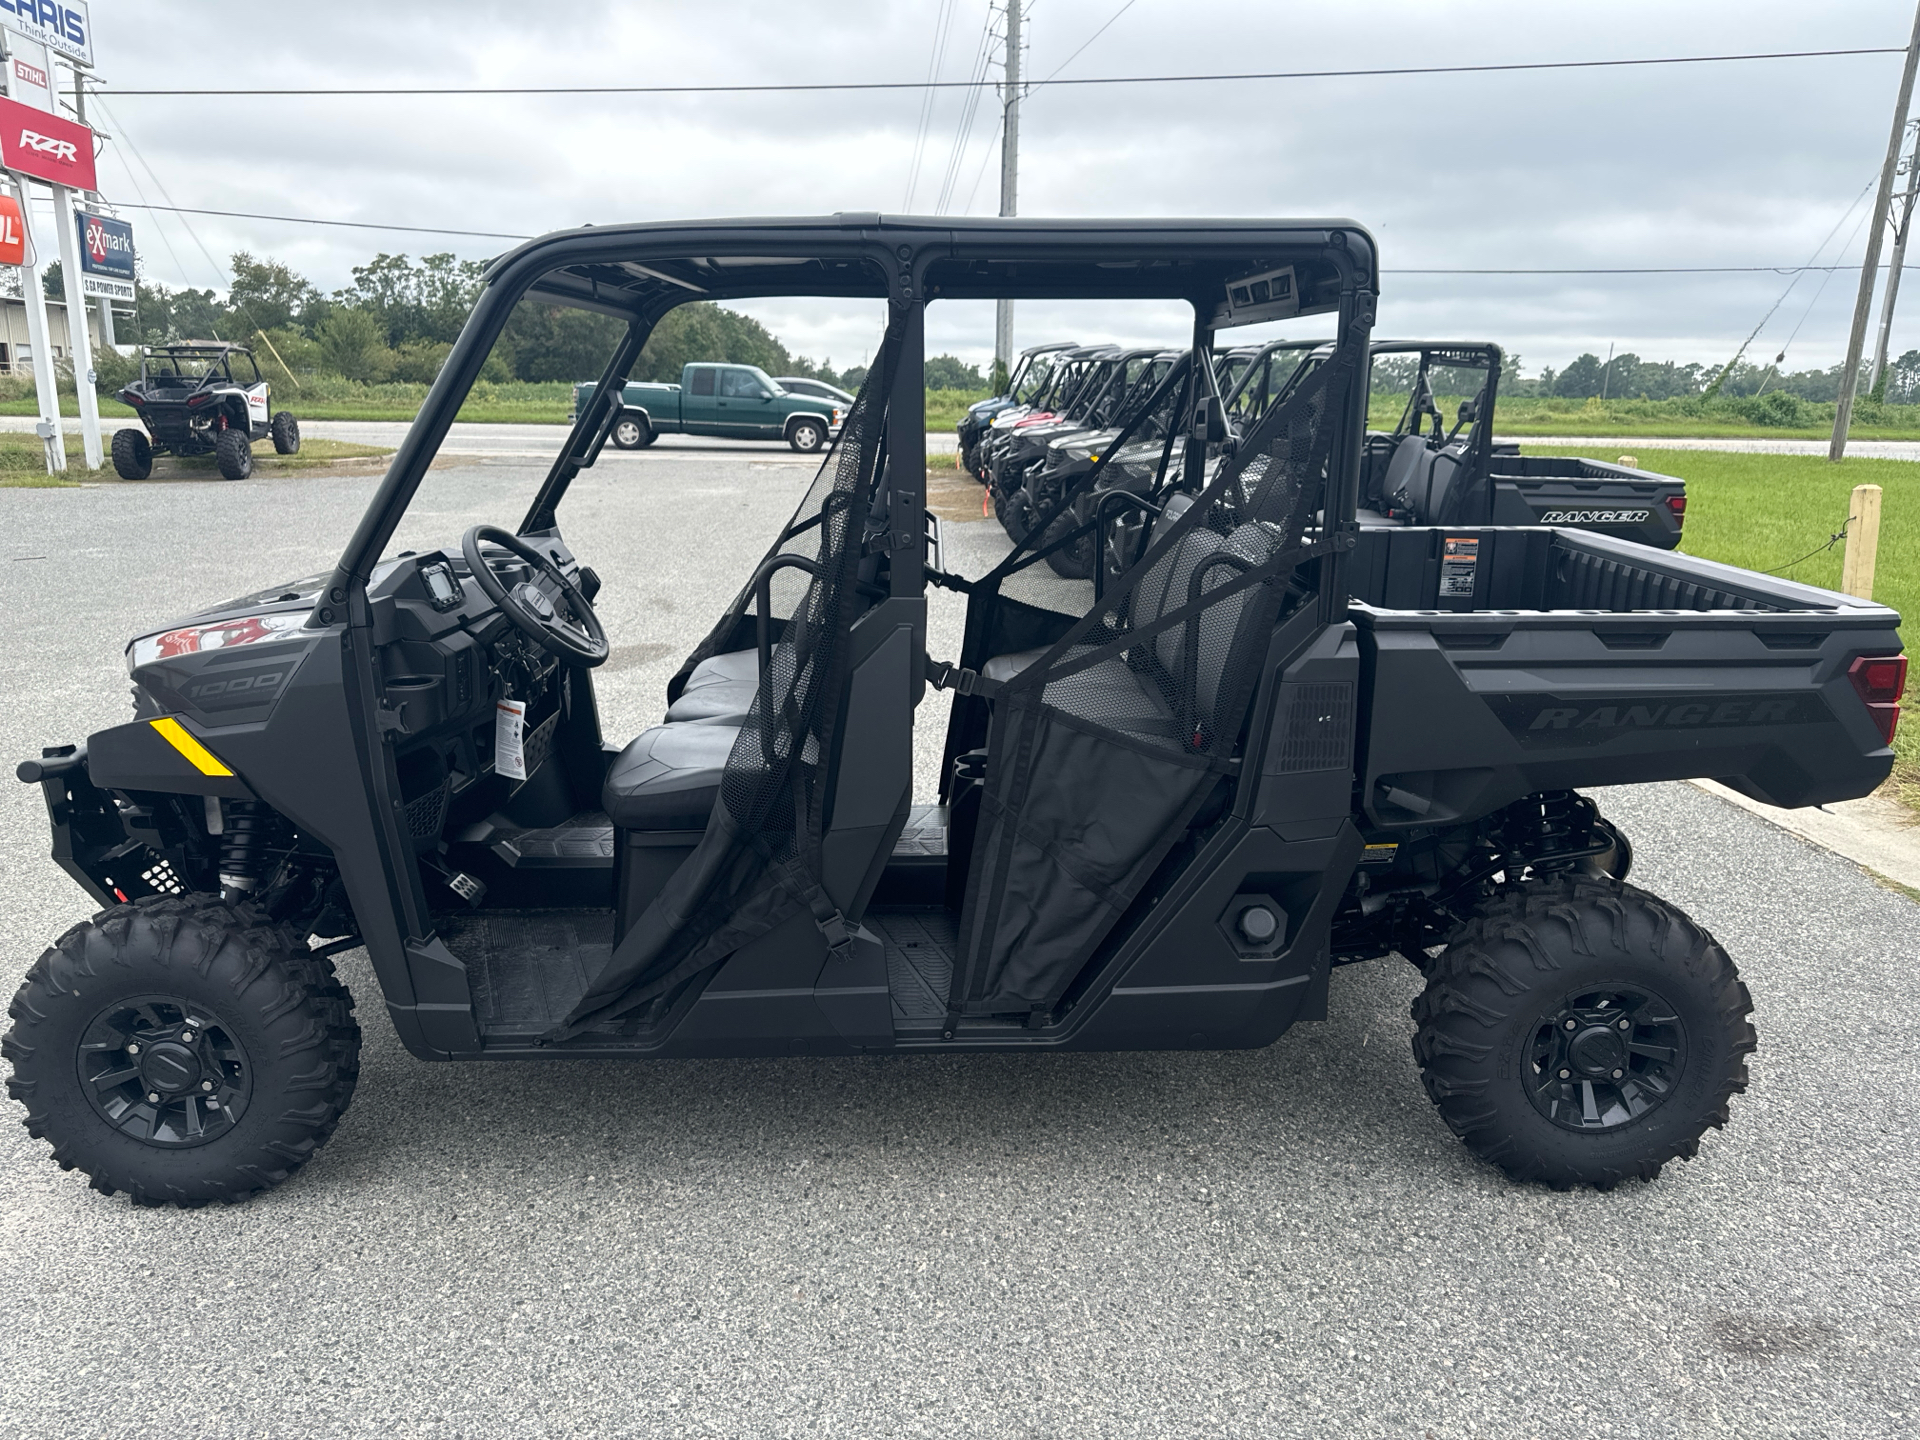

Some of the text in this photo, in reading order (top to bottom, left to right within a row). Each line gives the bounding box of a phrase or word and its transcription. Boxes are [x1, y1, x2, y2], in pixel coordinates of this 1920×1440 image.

[17, 18, 87, 60] Think Outside
[17, 64, 46, 86] STIHL
[19, 129, 77, 162] RZR
[96, 281, 114, 295] POWER
[114, 284, 133, 298] SPORTS
[1540, 510, 1649, 523] RANGER
[190, 672, 283, 699] 1000
[1528, 700, 1798, 730] RANGER
